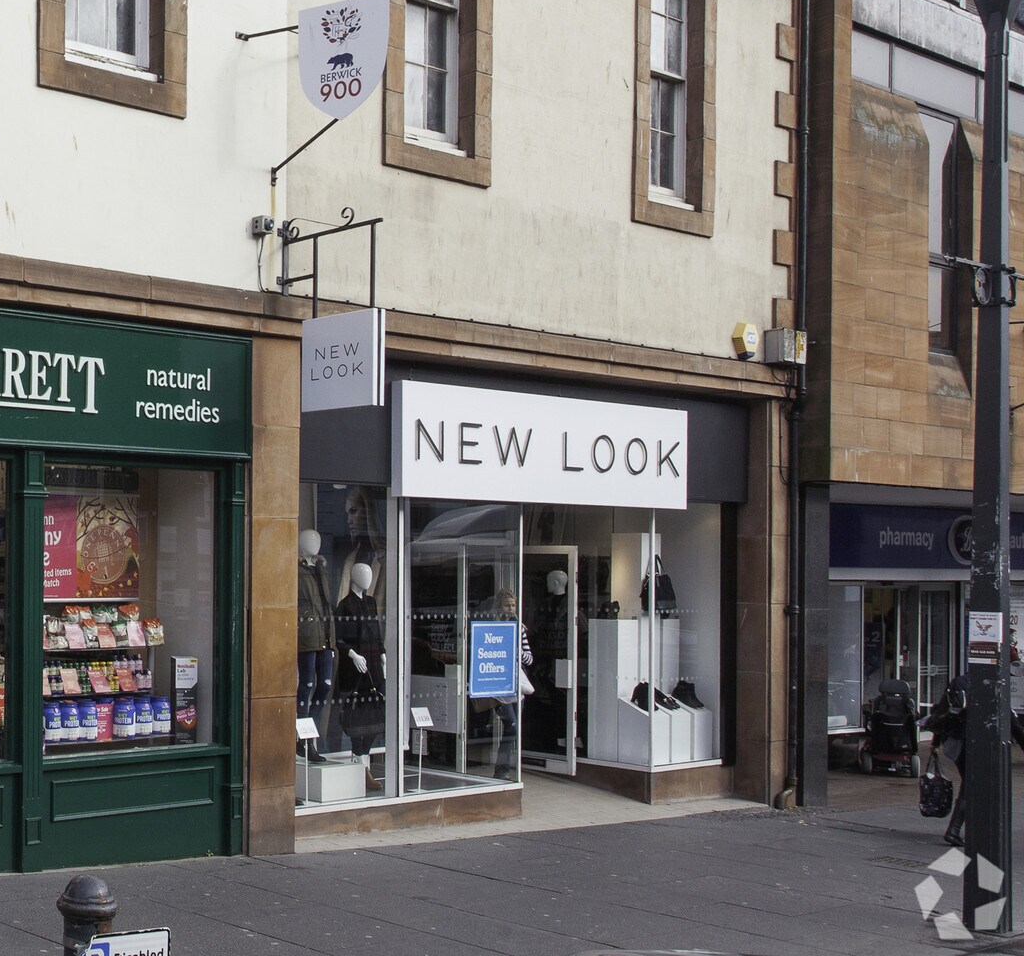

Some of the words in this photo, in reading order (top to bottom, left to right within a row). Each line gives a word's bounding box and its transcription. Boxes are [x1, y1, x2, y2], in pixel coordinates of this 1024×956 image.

[320, 66, 362, 84] BERWICK
[320, 78, 362, 102] 900
[314, 341, 360, 361] NEW
[146, 367, 211, 391] natural
[310, 361, 364, 381] LOOK
[135, 398, 220, 424] remedies
[414, 418, 533, 467] NEW
[561, 431, 680, 479] LOOK
[879, 526, 934, 550] pharmacy
[55, 568, 72, 577] items
[484, 632, 504, 644] New
[477, 647, 507, 659] Season
[479, 662, 505, 674] Offers
